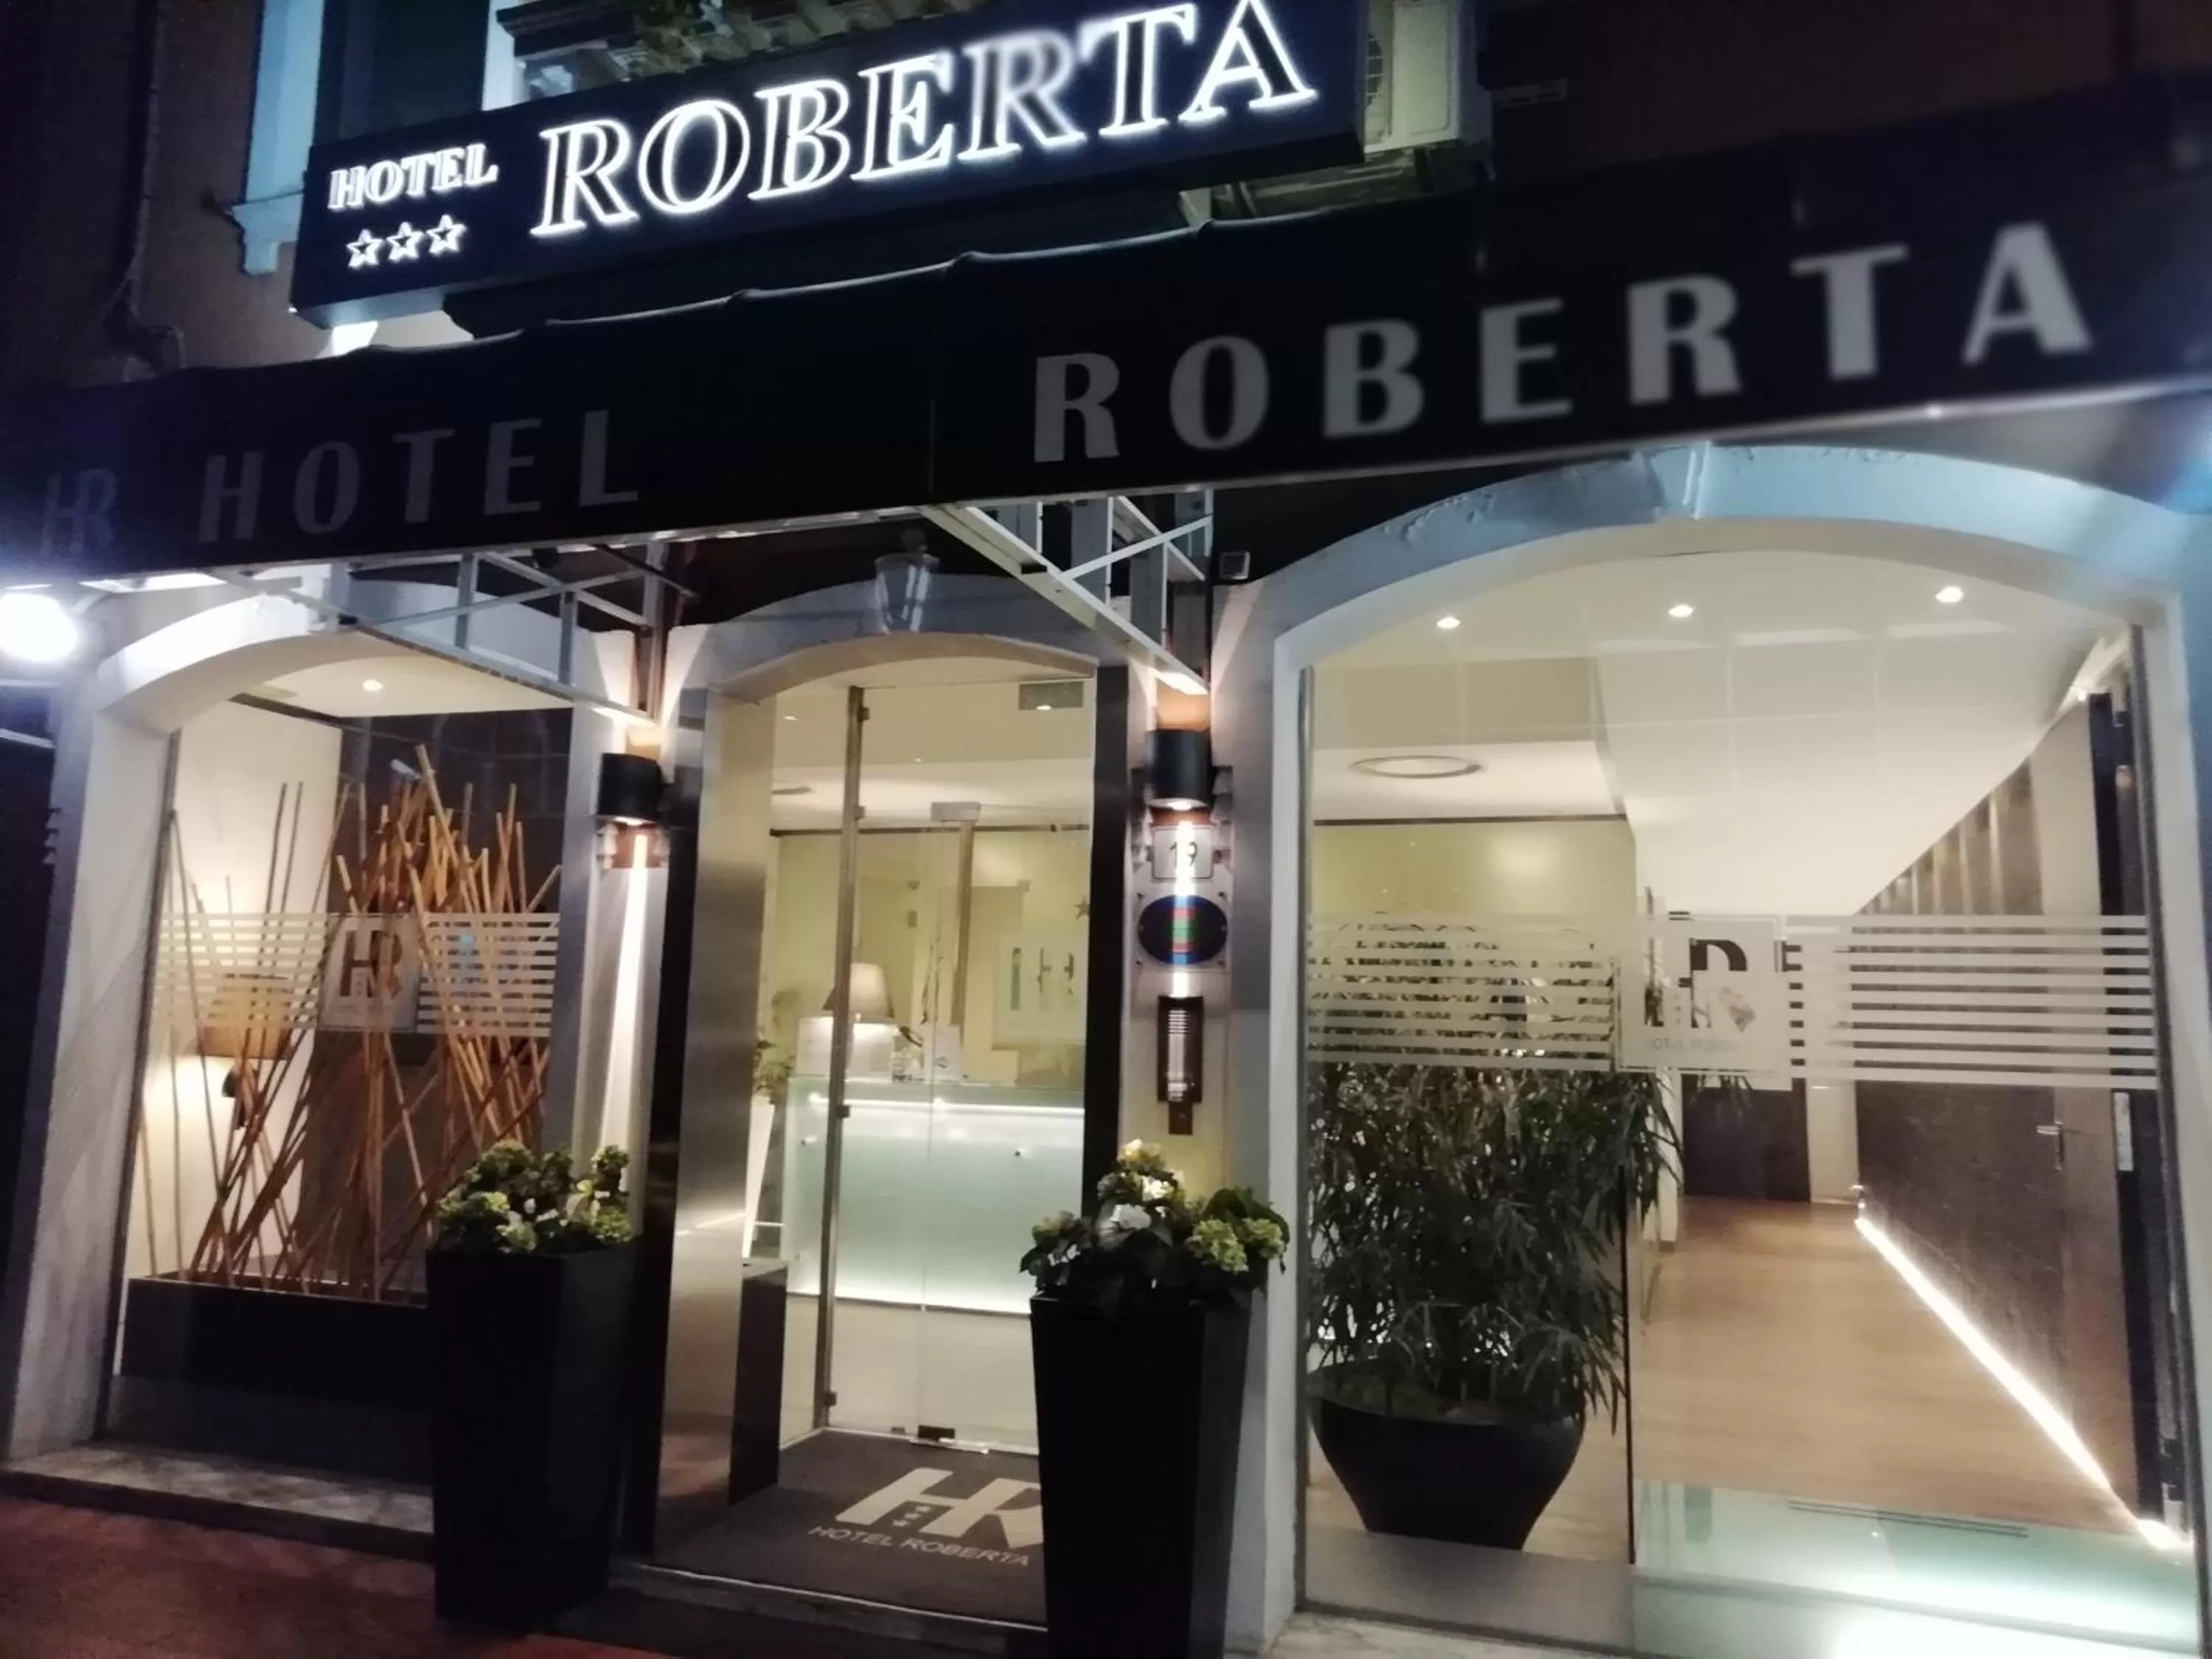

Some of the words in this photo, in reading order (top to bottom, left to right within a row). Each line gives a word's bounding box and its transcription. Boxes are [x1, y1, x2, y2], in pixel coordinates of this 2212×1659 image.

[328, 143, 499, 212] HOTEL
[529, 0, 1318, 237] ROBERTA
[40, 467, 120, 557] HR
[198, 409, 639, 543] HOTEL
[1033, 222, 2093, 464] ROBERTA
[807, 1526, 894, 1546] HOTEL
[900, 1537, 1029, 1566] ROBERTA
